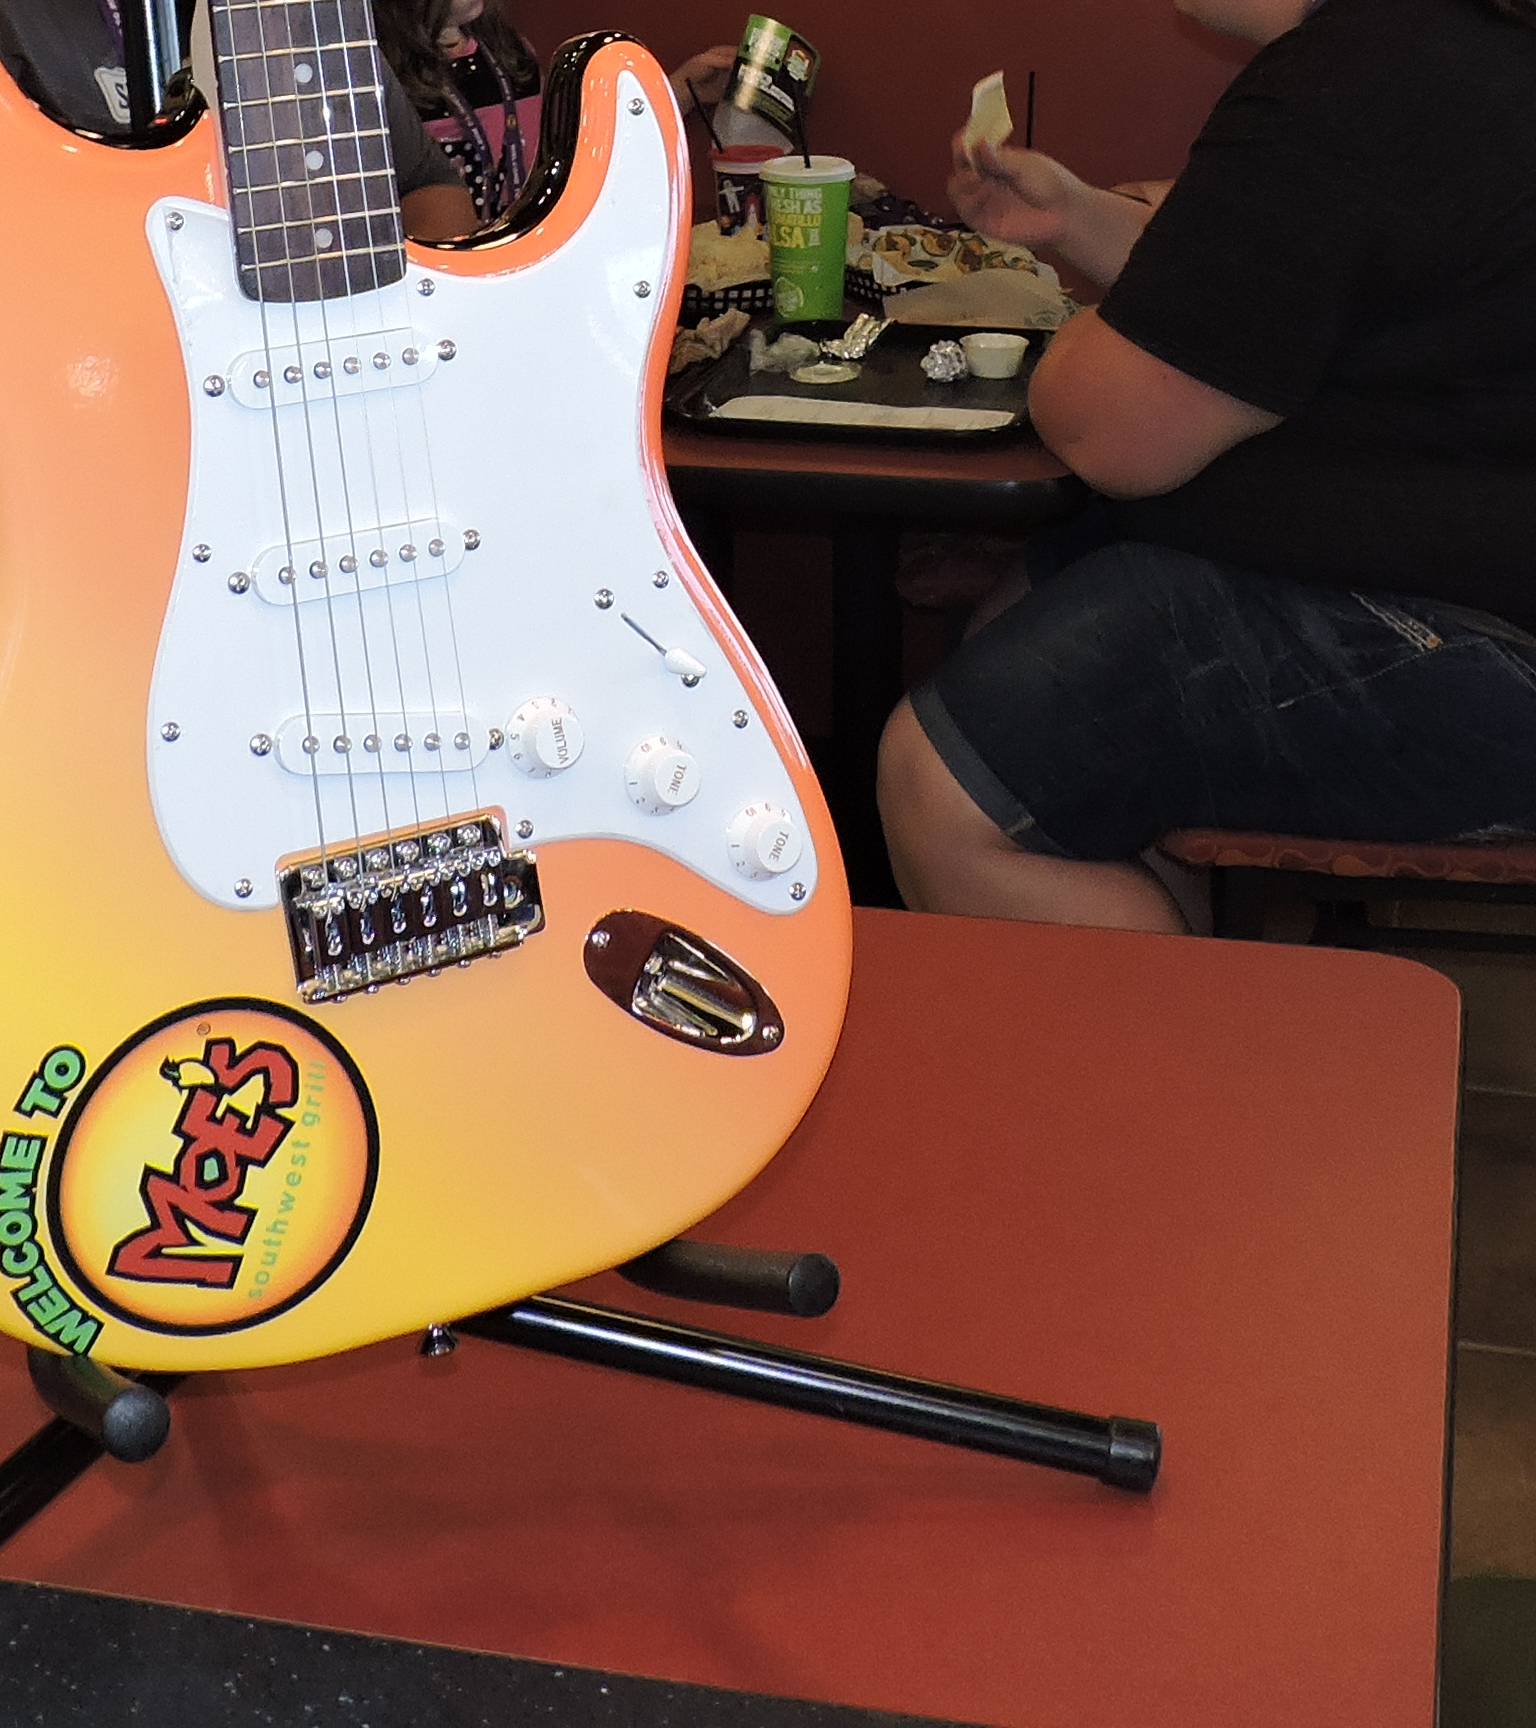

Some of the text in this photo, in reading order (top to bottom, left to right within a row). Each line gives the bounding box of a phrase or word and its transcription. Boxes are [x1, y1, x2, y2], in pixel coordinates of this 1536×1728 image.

[551, 717, 569, 764] VOLUME
[667, 765, 687, 796] TONE
[769, 831, 789, 861] TONE
[14, 1045, 86, 1119] TO
[248, 1060, 327, 1299] southwest grill
